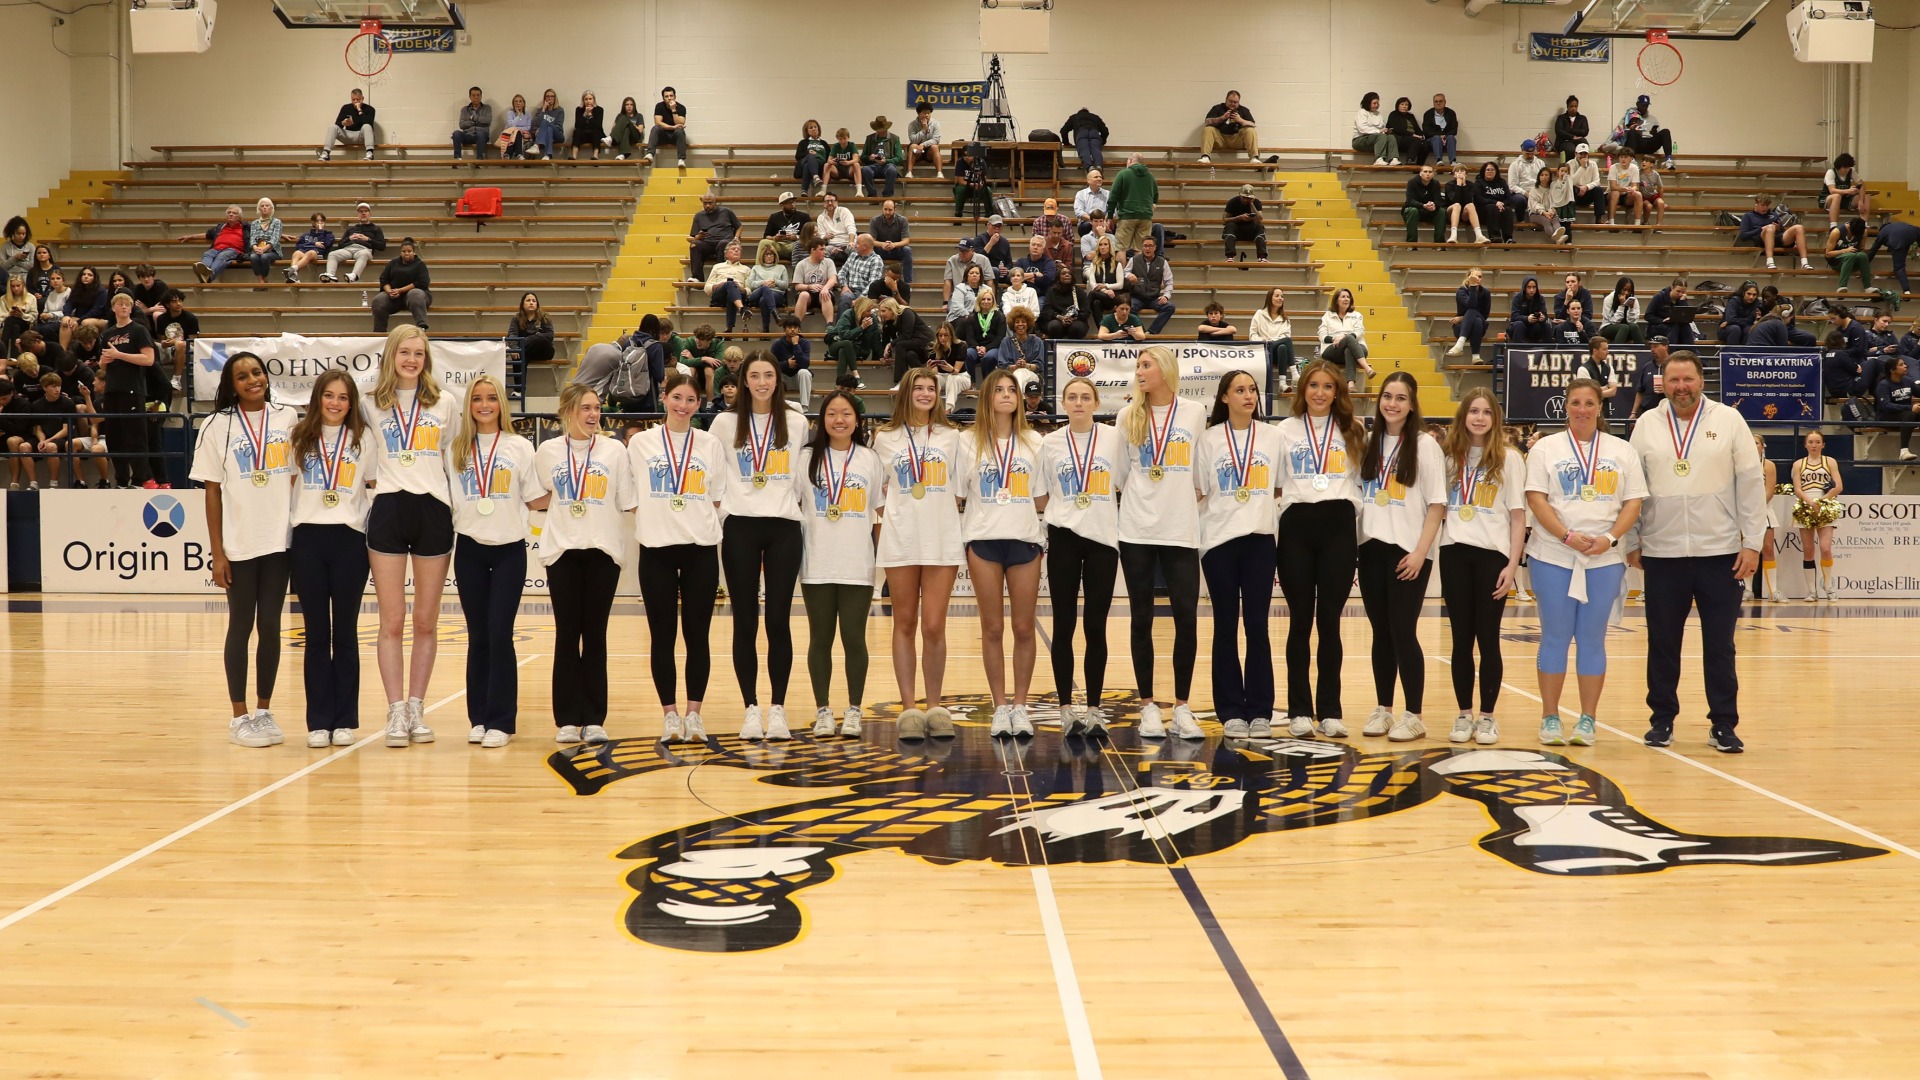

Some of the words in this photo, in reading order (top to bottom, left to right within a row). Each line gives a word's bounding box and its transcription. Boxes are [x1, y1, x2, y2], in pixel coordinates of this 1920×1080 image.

[1551, 38, 1589, 47] HOME
[1534, 48, 1606, 58] OVERFLOW
[913, 83, 983, 93] VISITOR
[915, 95, 981, 104] ADULTS
[1102, 349, 1139, 359] THAN
[1183, 349, 1255, 359] SPONSORS
[1528, 354, 1574, 371] LADY
[1729, 358, 1764, 366] STEVEN
[1774, 358, 1814, 367] KATRINA
[1746, 371, 1797, 379] BRADFORD
[1165, 441, 1191, 467] DID
[1290, 450, 1315, 475] WE
[923, 461, 947, 487] DID
[1801, 472, 1832, 485] SCOTS
[1846, 536, 1885, 545] RENNA
[63, 541, 169, 580] Origin
